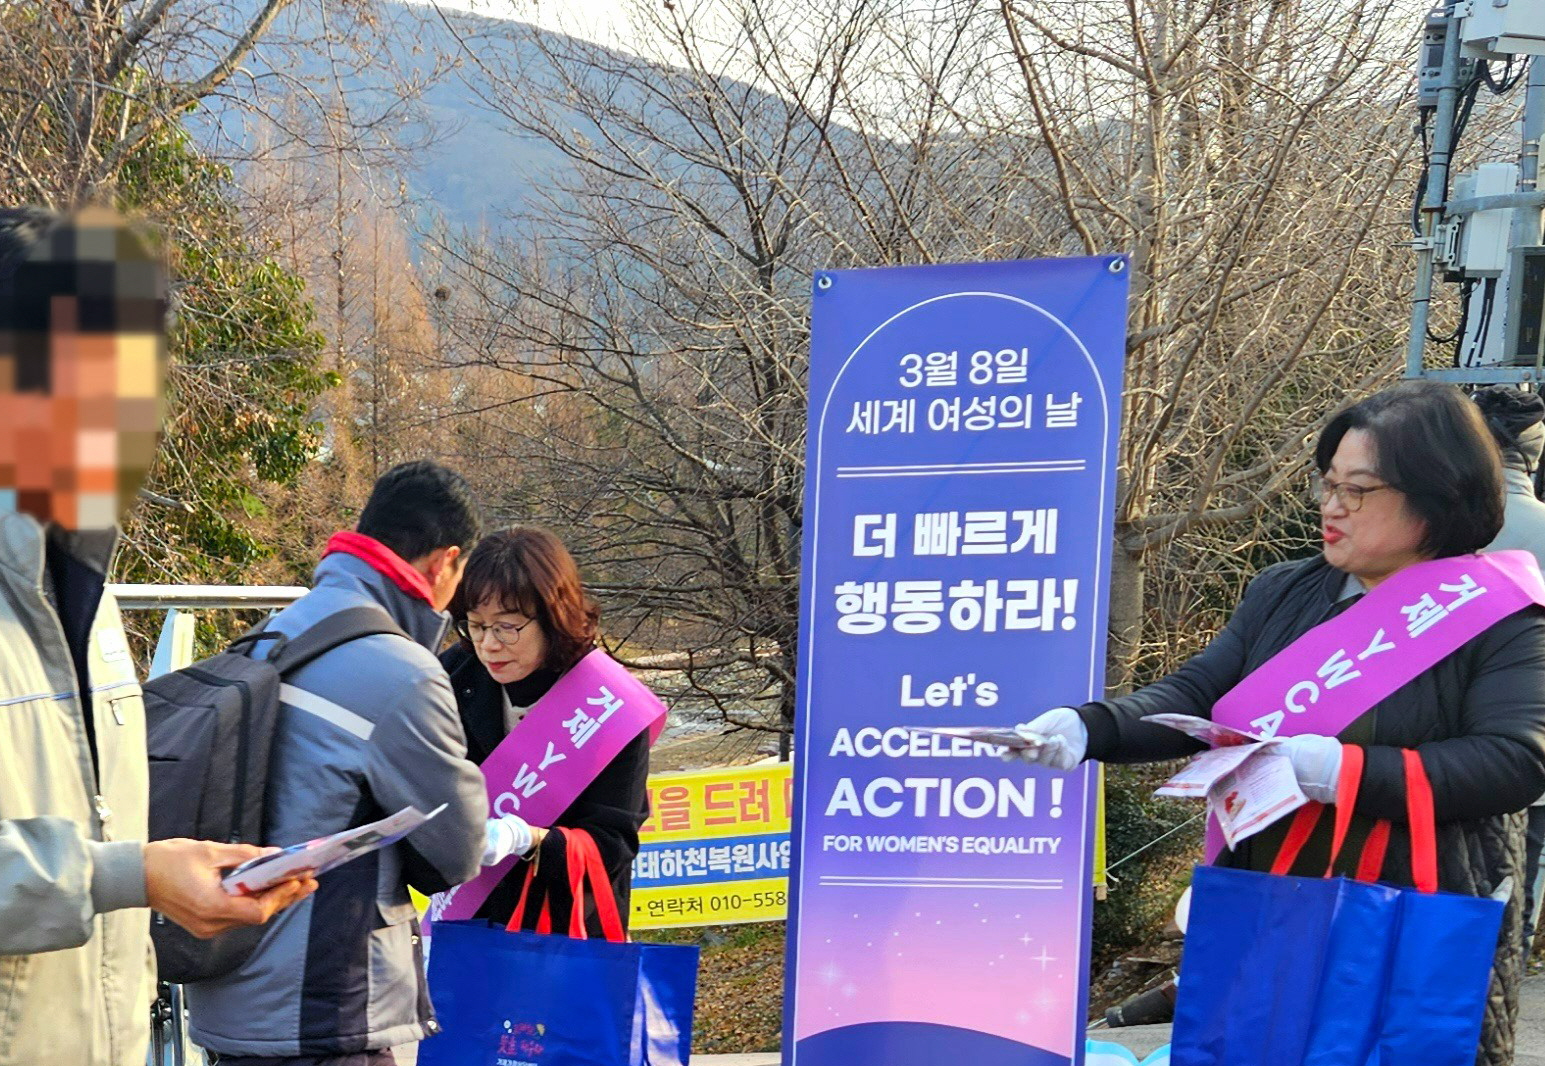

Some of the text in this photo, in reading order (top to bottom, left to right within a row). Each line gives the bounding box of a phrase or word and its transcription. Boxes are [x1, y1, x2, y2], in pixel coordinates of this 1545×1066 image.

[898, 348, 1029, 388] 3월 8일
[846, 391, 1083, 435] 세계 여성의 날
[852, 508, 1058, 558] 더 빠르게
[834, 578, 1079, 635] 행동하라!
[1400, 574, 1487, 638] 거제
[900, 673, 999, 708] Let's
[494, 685, 624, 818] 거제 YWC
[704, 779, 771, 826] 드려
[823, 835, 1061, 855] FOR WOMEN'S EQUALITY
[647, 891, 787, 917] 연락처 010-558
